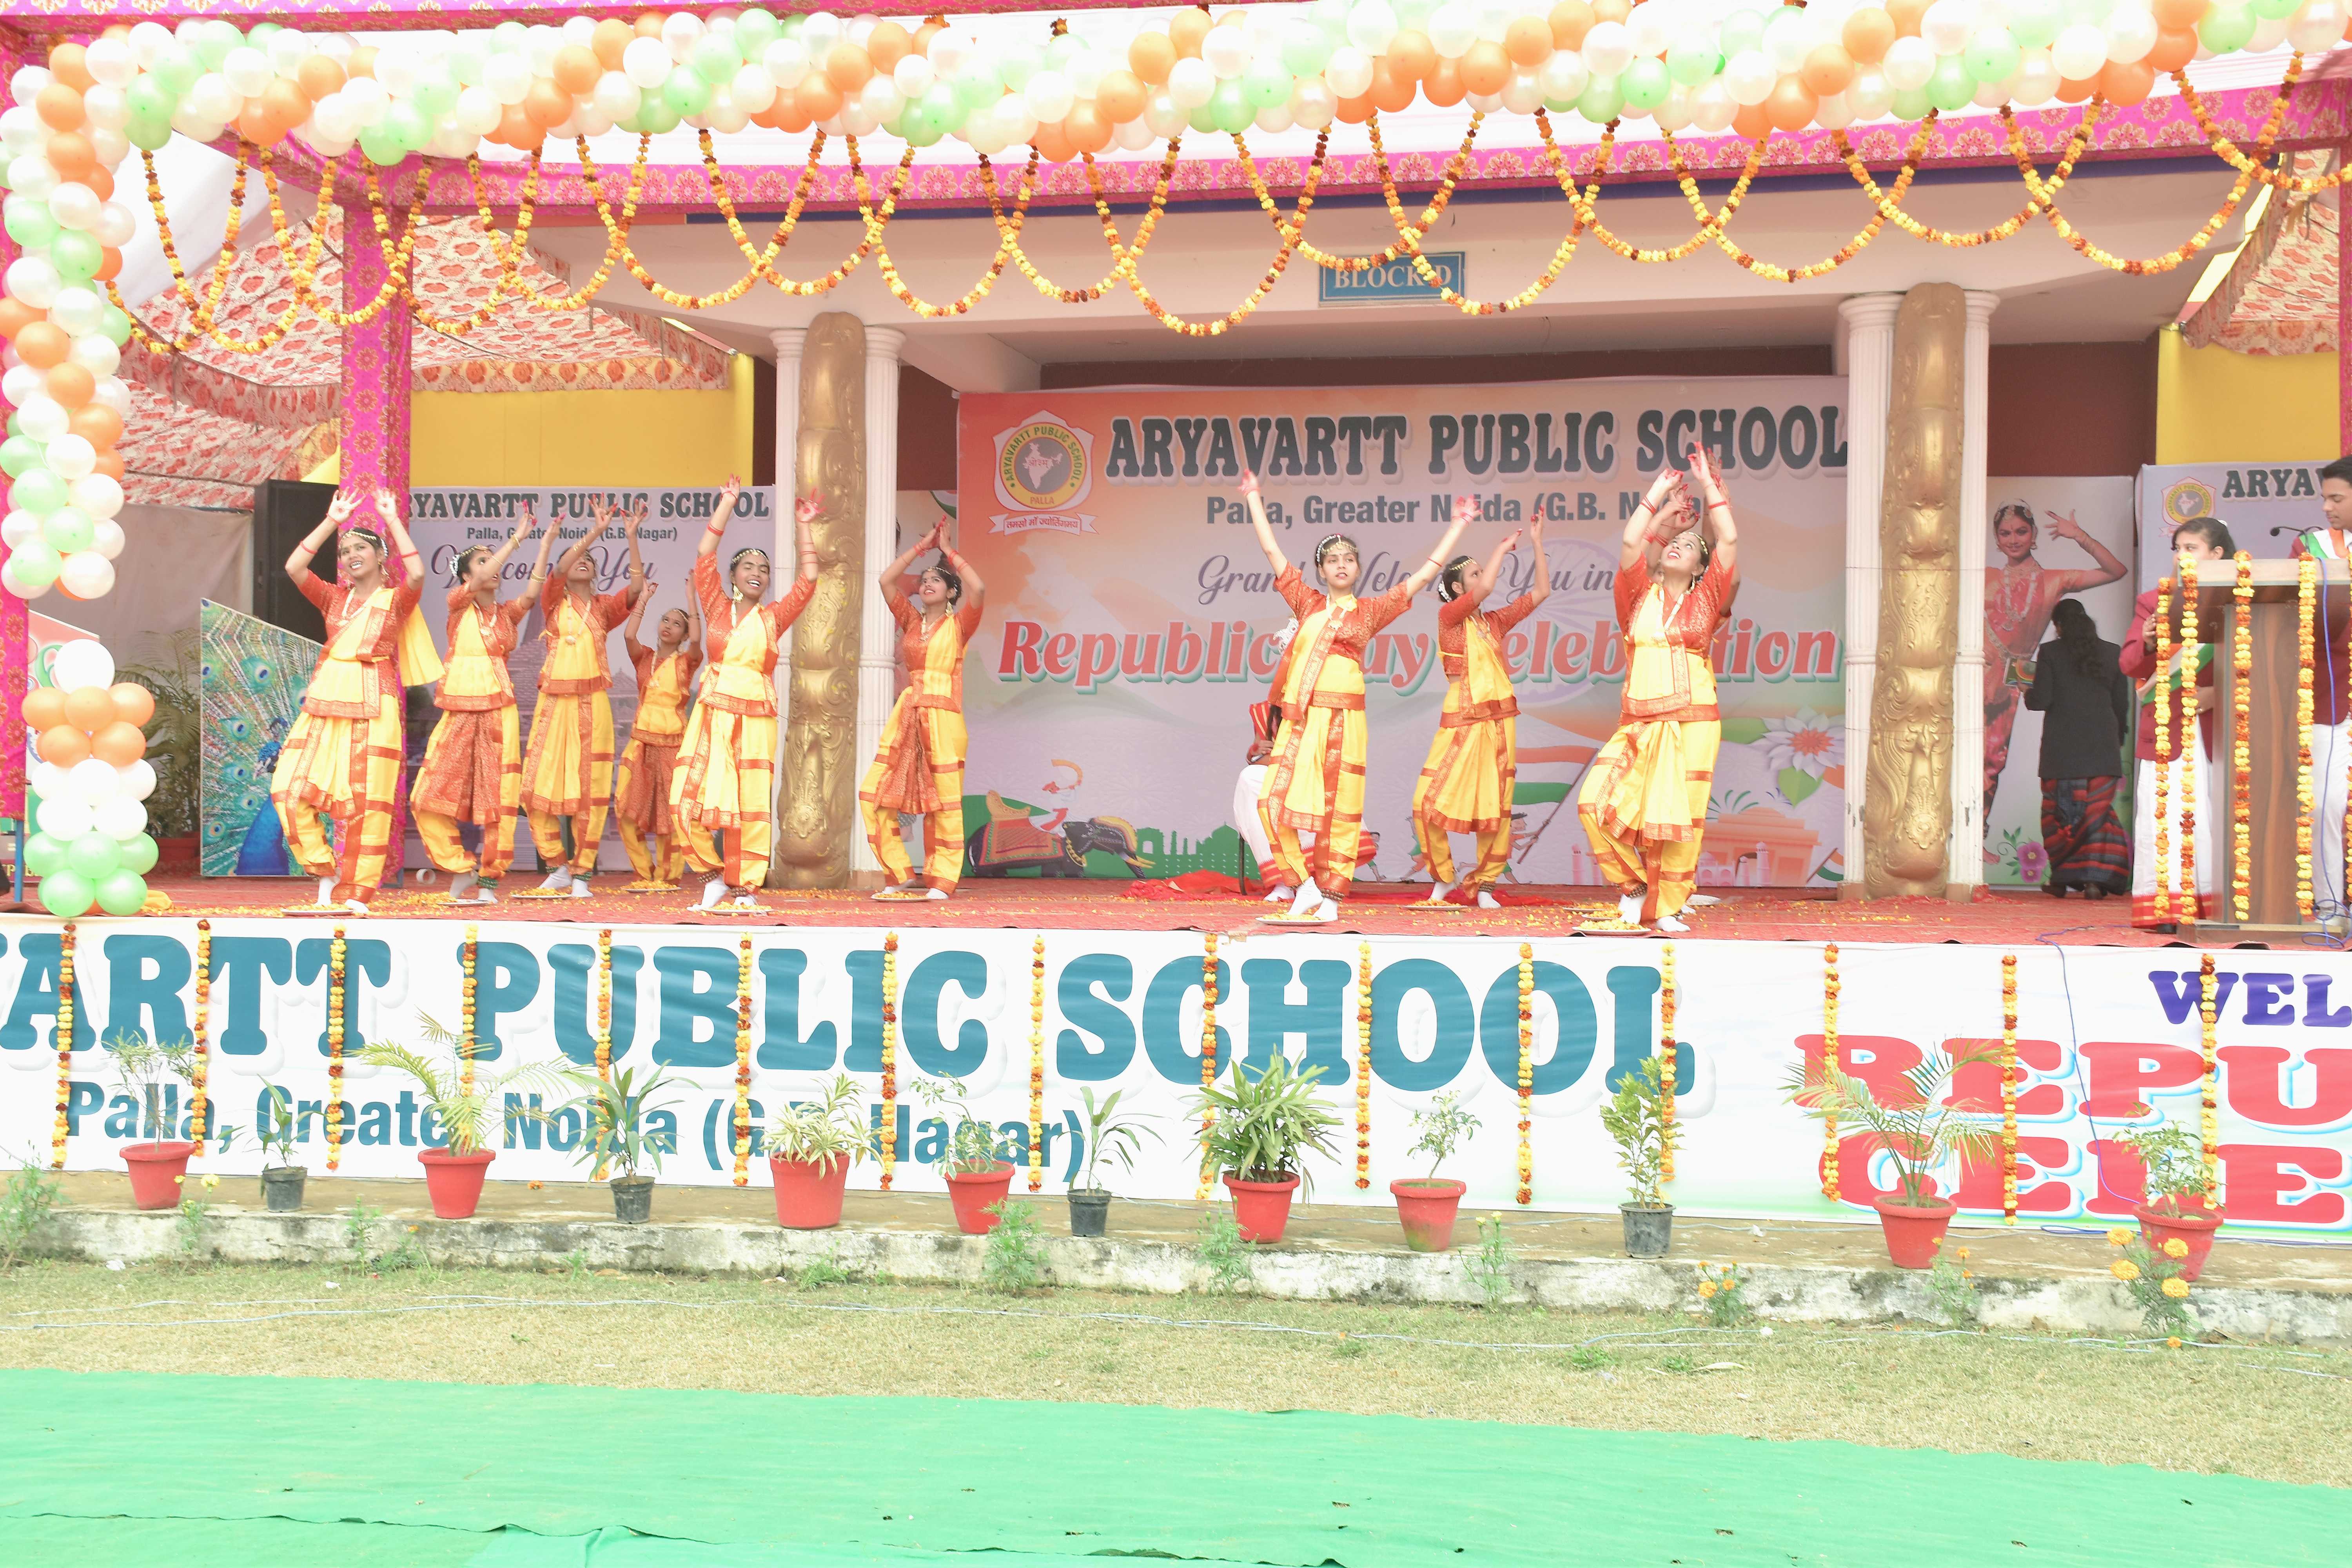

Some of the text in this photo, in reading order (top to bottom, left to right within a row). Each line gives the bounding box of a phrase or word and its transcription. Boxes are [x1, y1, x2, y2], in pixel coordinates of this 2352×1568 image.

[1003, 426, 1082, 481] ARYAVARTT PUBLIC SCHOOL
[1106, 405, 1847, 477] ARYAVARTT PUBLIC SCHOOL
[409, 493, 539, 518] YAVARTT
[660, 492, 769, 518] SCHOL
[1030, 496, 1054, 505] PALLA
[1207, 496, 1292, 530] Pala,
[1304, 495, 1420, 524] Greater
[1431, 493, 1521, 522] Nida
[467, 527, 503, 541] Palla,
[506, 527, 548, 539] Gate
[559, 527, 588, 539] Noid
[636, 527, 677, 542] Nagar)
[1498, 551, 1568, 604] Yu
[1583, 563, 1615, 592] in
[998, 618, 1836, 688] Republic ay elebtion
[0, 933, 1695, 1096] ARTT PUBLIC SCHOOL
[2148, 971, 2352, 1027] WEL
[1793, 1034, 2352, 1125] REPU
[67, 1082, 234, 1154] Palla,
[256, 1085, 451, 1149] Greate
